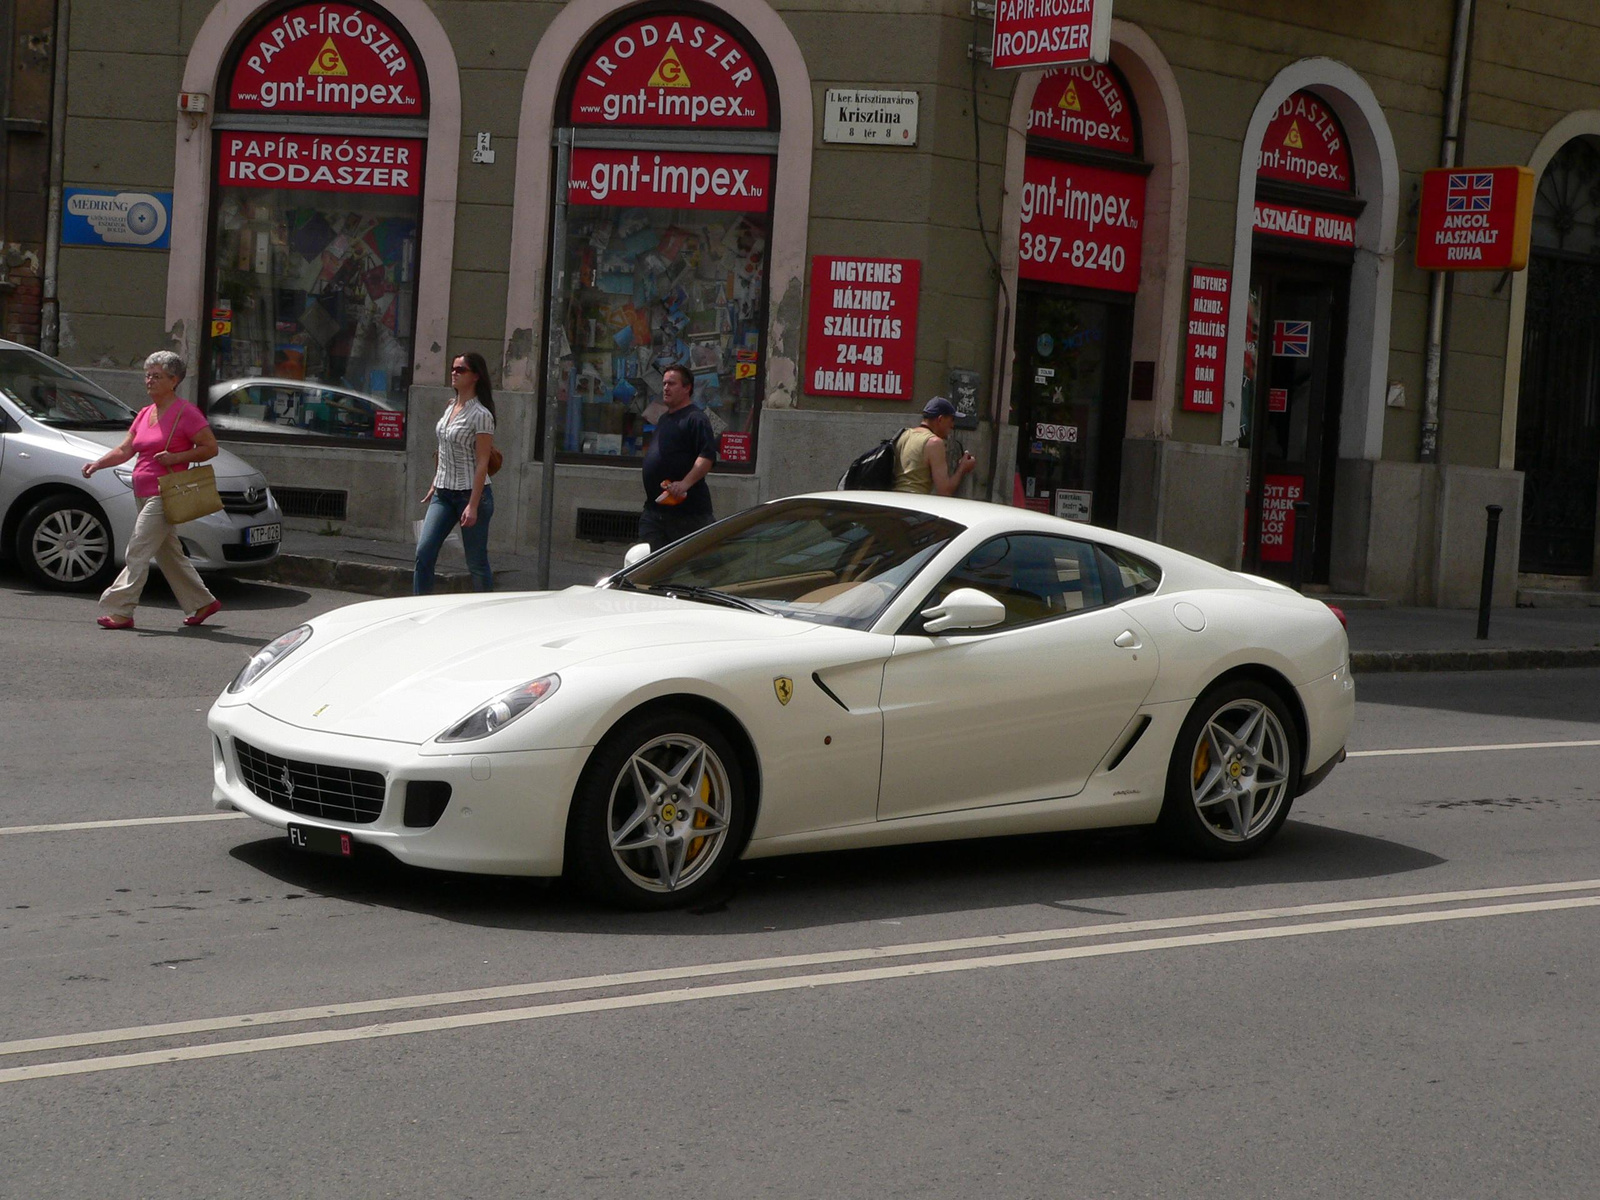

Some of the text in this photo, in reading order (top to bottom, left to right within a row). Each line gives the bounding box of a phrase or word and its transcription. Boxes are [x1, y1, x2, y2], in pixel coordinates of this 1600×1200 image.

[247, 6, 407, 77] PAPÍR-ÍRÓSZER
[996, 24, 1089, 57] IRODASZER
[586, 21, 753, 88] IRODASZER
[238, 76, 416, 110] www.gnt-impex.hu
[855, 94, 914, 105] Krisztinaváros
[580, 88, 755, 122] www.gnt-impex.hu
[839, 107, 901, 123] Krisztina
[849, 128, 891, 138] 8 tér 8
[231, 137, 409, 165] PAPÍR-ÍRÓSZER
[229, 161, 409, 187] IRODASZER
[71, 199, 129, 211] MEDIRING
[1020, 176, 1138, 232] gnt-impex.hu
[1252, 206, 1353, 242] ASZNÁLT RUHA
[1443, 214, 1490, 228] ANGOL
[1435, 228, 1499, 245] HASZNÁLT
[1019, 232, 1125, 273] 387-8240
[1447, 246, 1482, 260] RUHA
[830, 261, 902, 284] INGYENES
[1193, 275, 1227, 292] INGYENES
[833, 285, 895, 311] HÁZHOZ-
[1193, 296, 1223, 314] HÁZHOZ-
[823, 313, 901, 339] SZÁLLÍTÁS
[1189, 319, 1226, 338] SZÁLLÍTÁS
[836, 343, 883, 366] 24-48
[1195, 344, 1217, 359] 24-48
[814, 366, 902, 394] ÓRÁN BELÜL
[1195, 364, 1214, 382] ÓRÁN
[1193, 388, 1213, 405] BELÜL
[1263, 498, 1294, 510] RMEK
